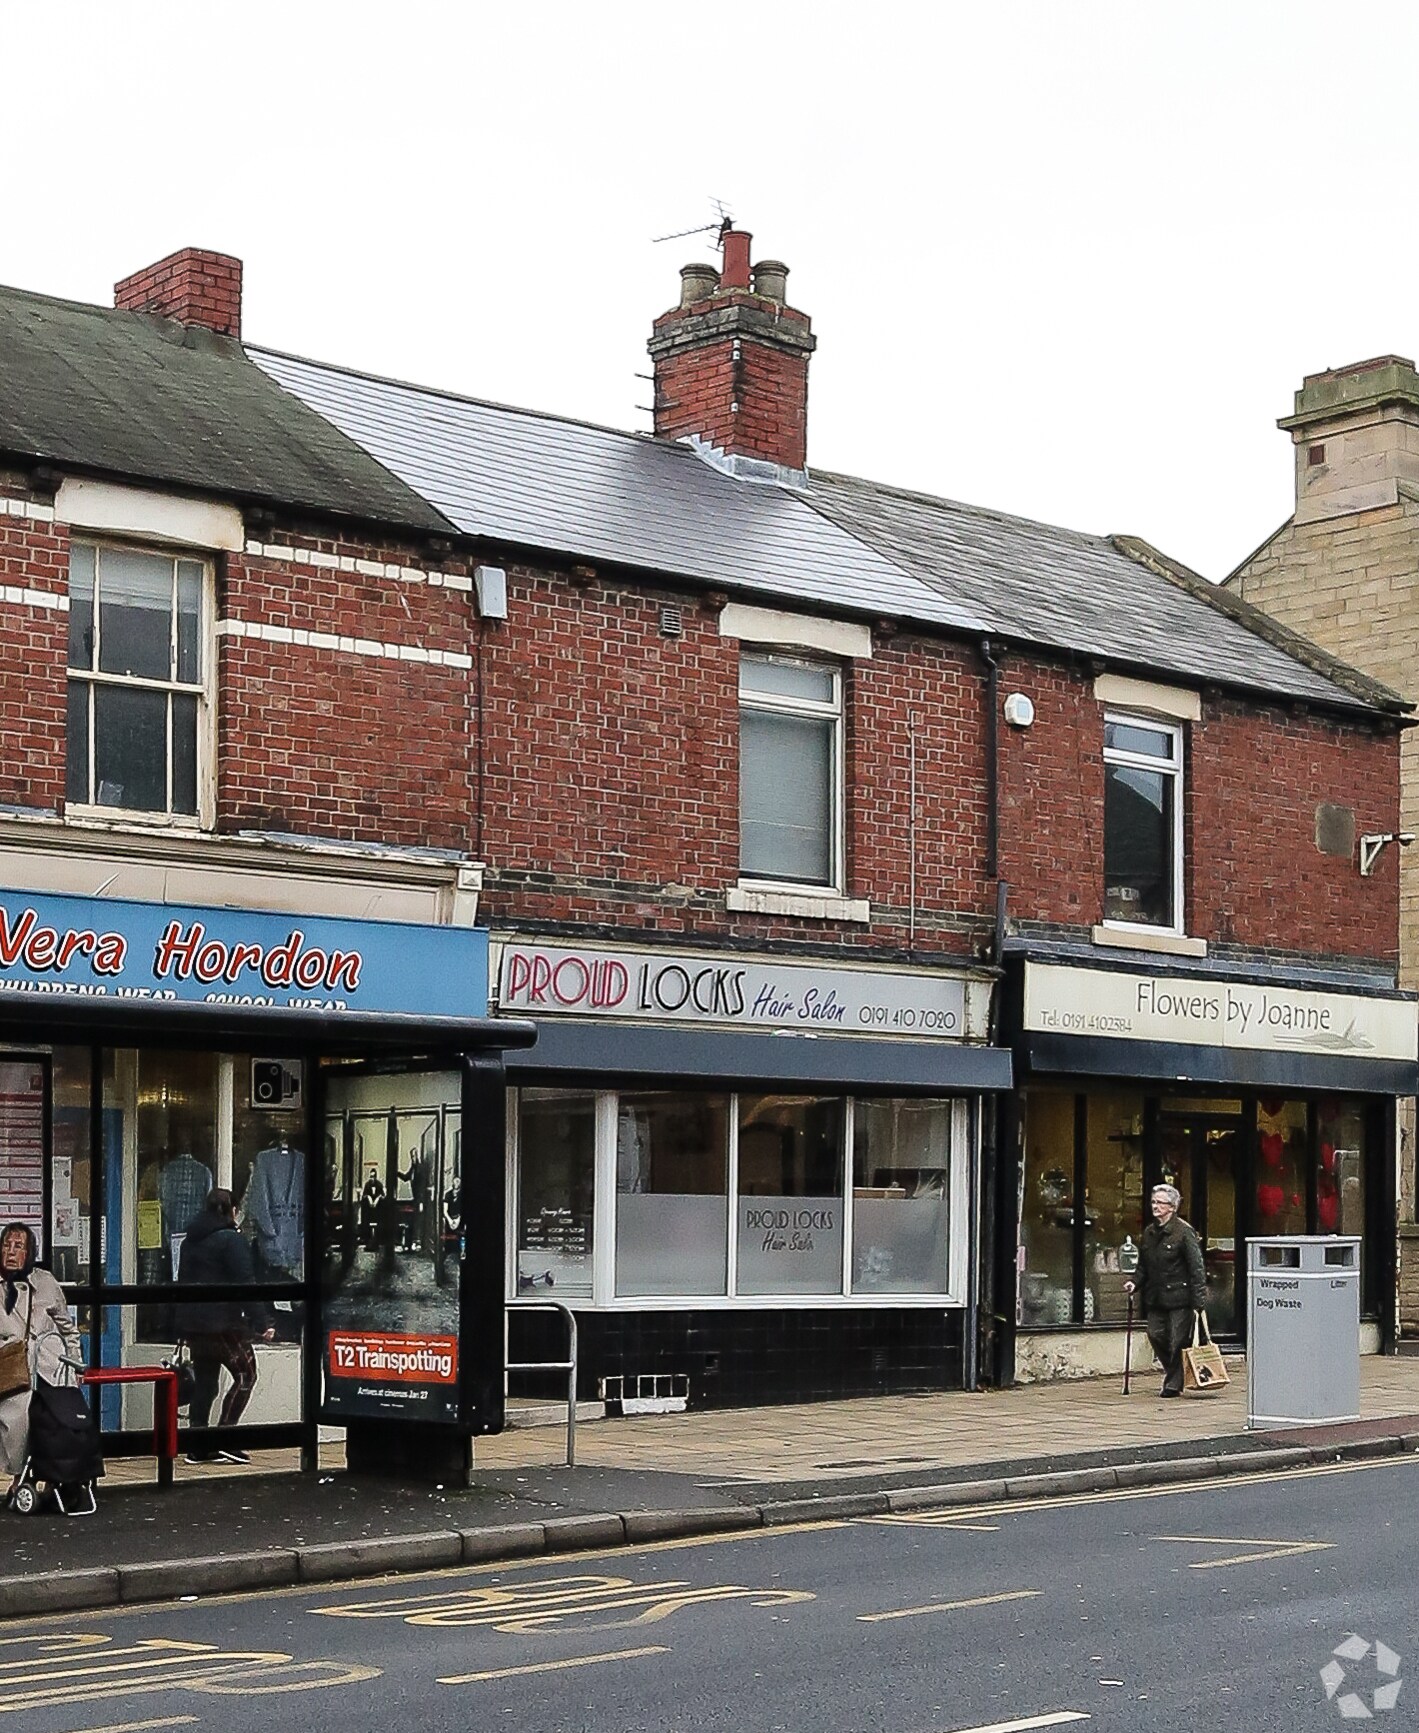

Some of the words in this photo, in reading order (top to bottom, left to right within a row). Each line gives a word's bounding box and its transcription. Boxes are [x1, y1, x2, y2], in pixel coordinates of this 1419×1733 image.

[0, 906, 127, 974] Vera
[153, 920, 363, 993] Hordon
[509, 953, 630, 1007] PROUD
[639, 963, 746, 1015] LOCKS
[751, 983, 795, 1018] Hair
[797, 988, 847, 1023] Salon
[859, 1006, 889, 1025] 0191
[892, 1009, 916, 1027] 410
[919, 1010, 957, 1030] 7020
[1061, 1012, 1086, 1029] 0191
[1137, 980, 1220, 1020] Flowers
[1226, 989, 1253, 1034] by
[1257, 995, 1331, 1030] Joanne
[746, 1209, 790, 1230] PROUD
[793, 1210, 834, 1231] LOCKS
[1260, 1279, 1299, 1290] Wrapped
[1256, 1298, 1274, 1309] Dog
[1274, 1298, 1303, 1309] Waste
[333, 1344, 356, 1368] T2
[355, 1346, 452, 1377] Trainspotting
